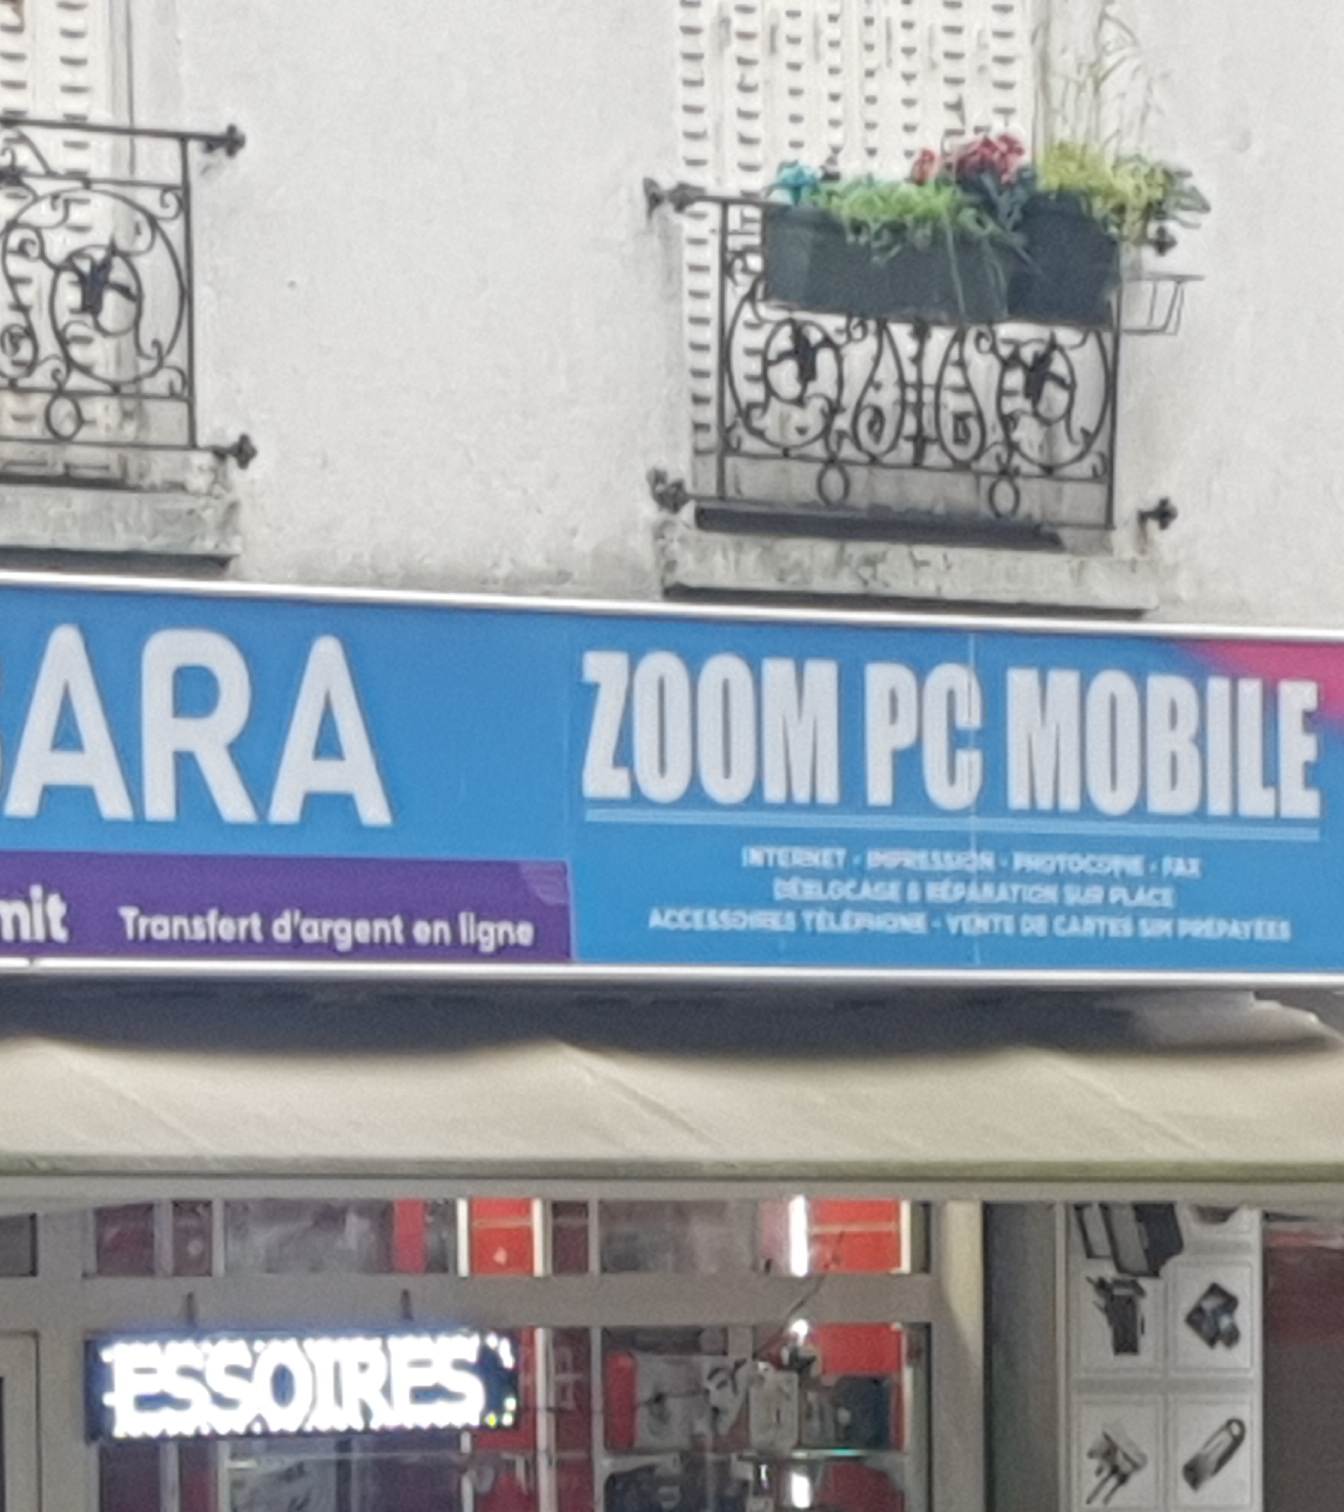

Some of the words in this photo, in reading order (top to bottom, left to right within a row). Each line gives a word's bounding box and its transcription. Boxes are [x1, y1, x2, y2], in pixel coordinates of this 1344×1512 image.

[582, 650, 839, 804] ZOOM
[865, 662, 983, 811] PC
[1007, 667, 1321, 819] MOBILE
[741, 845, 847, 868] INTERNET
[1161, 855, 1202, 878] FAX
[118, 906, 264, 943] Transfert
[271, 910, 406, 951] d'argent
[413, 920, 453, 947] en
[459, 912, 535, 950] ligne
[102, 1334, 485, 1437] ESSOIRES
